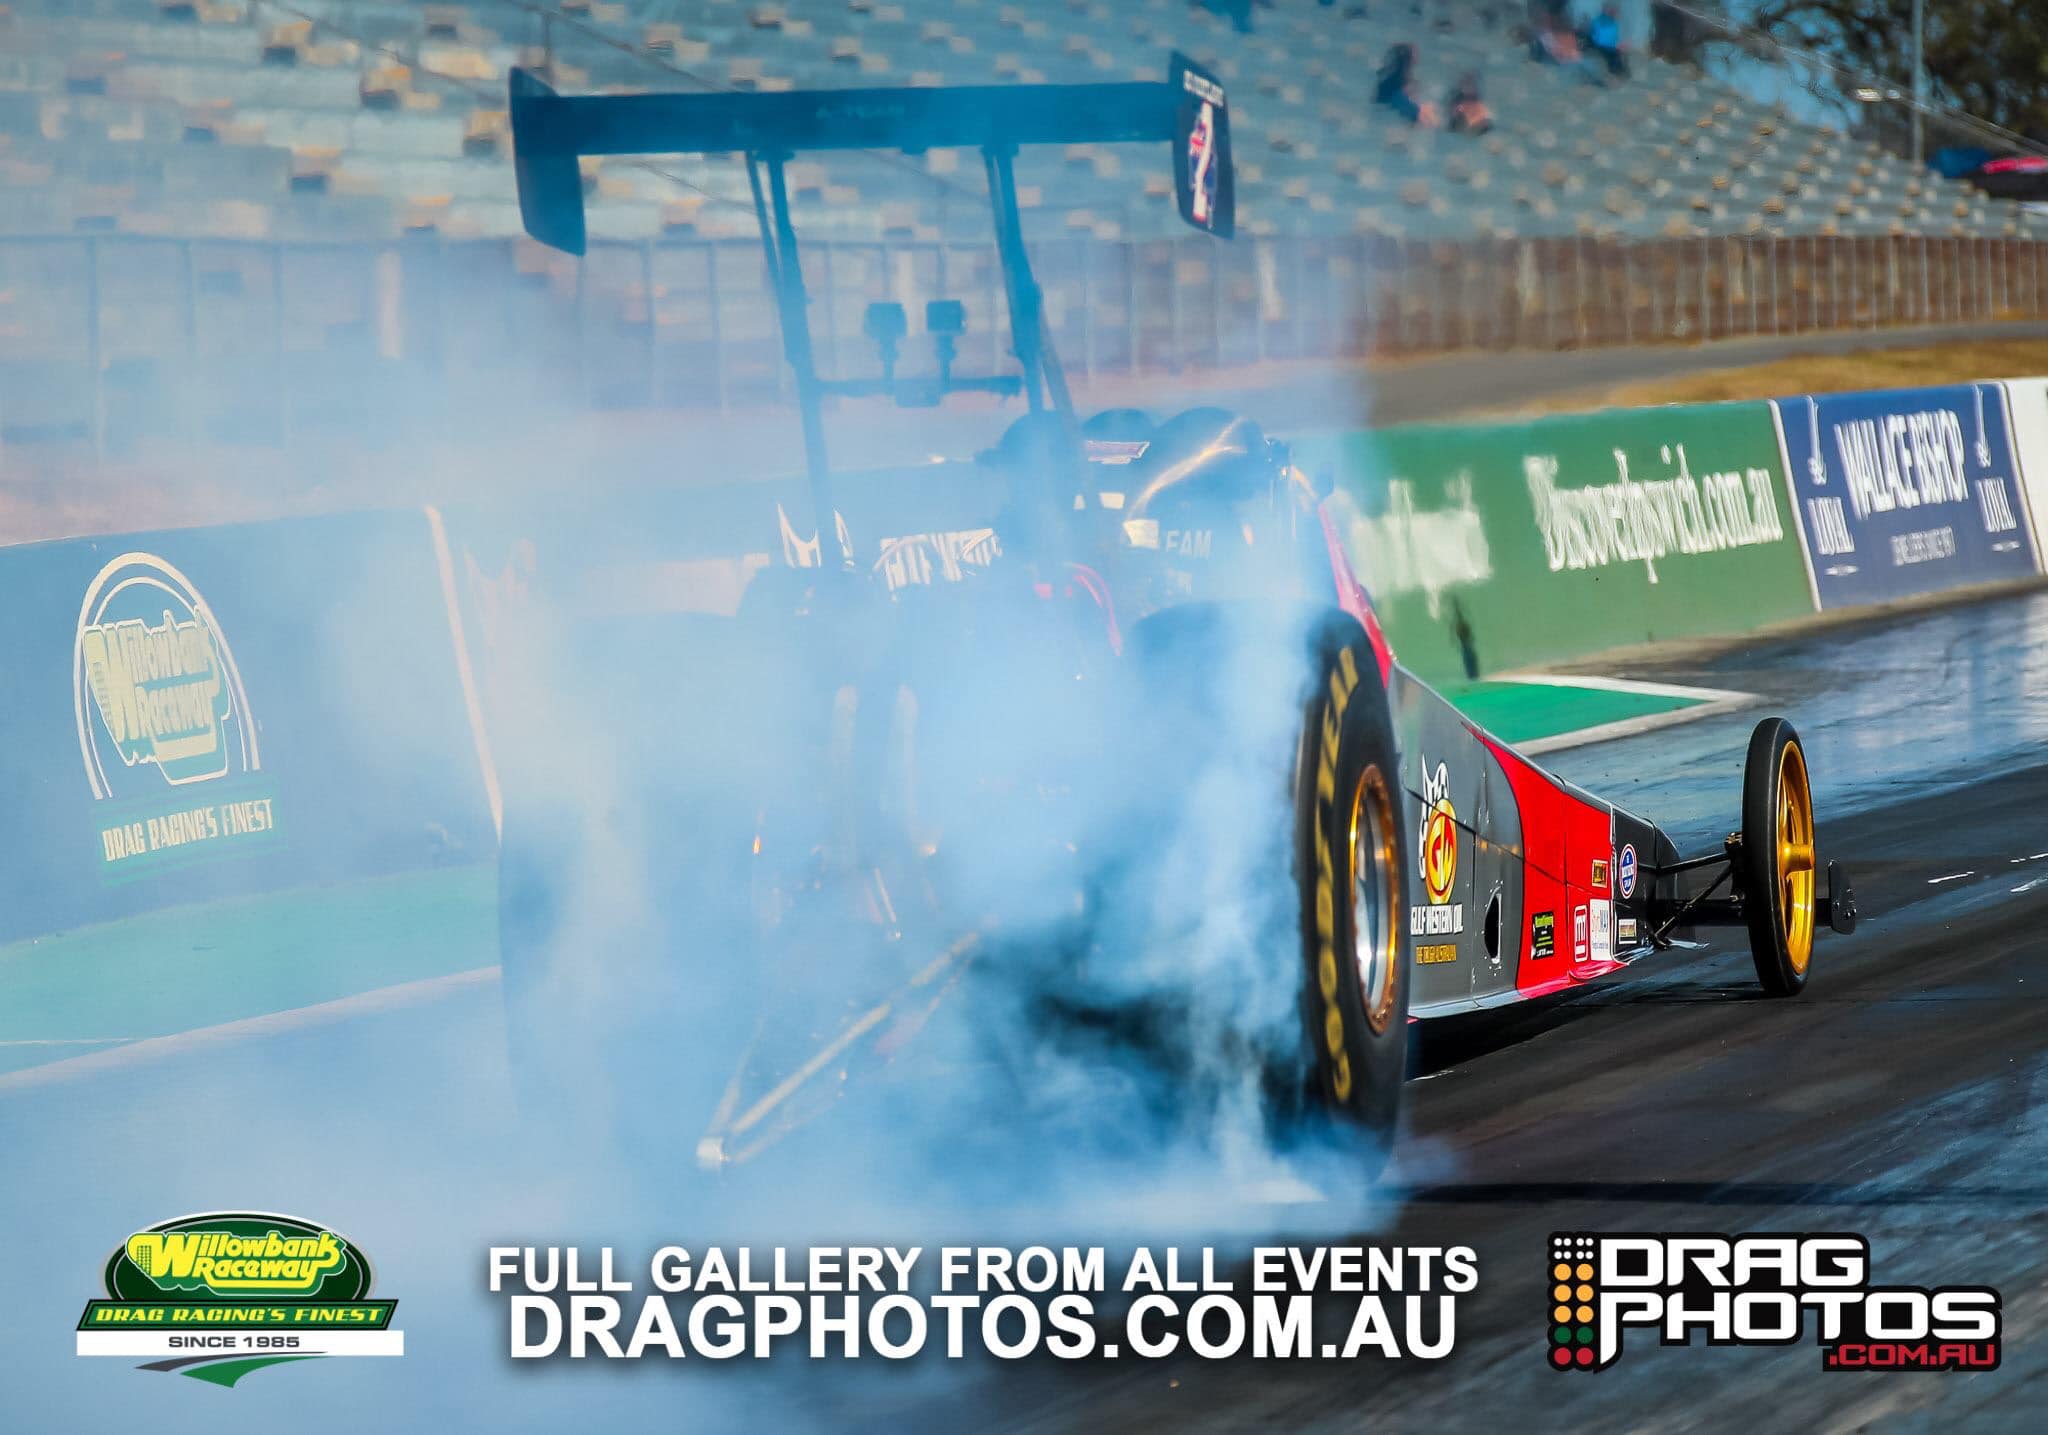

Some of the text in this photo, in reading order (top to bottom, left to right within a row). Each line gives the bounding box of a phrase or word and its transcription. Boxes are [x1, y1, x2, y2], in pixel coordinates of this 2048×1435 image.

[1834, 409, 1969, 521] WALLACE BISHOP
[102, 799, 273, 862] DRAG RACING'S FINEST
[1314, 645, 1359, 1103] GOODYEAR
